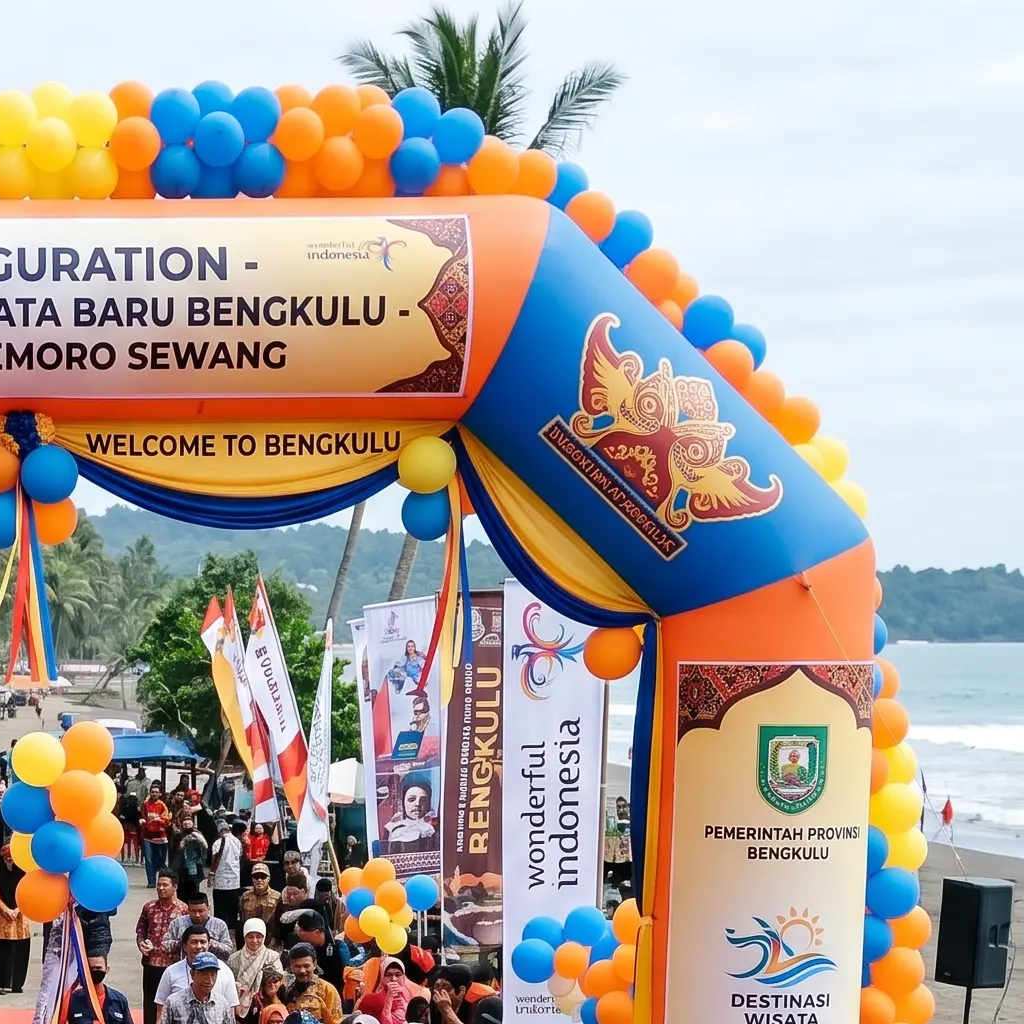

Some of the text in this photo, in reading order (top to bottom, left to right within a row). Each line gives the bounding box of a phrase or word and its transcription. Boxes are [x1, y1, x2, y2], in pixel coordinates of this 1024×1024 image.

[307, 249, 370, 260] indonesia
[73, 297, 174, 328] BARU
[187, 295, 387, 327] BENGKULU
[128, 341, 287, 370] SEWANG
[86, 431, 401, 458] WELCOME TO BENGKULU
[520, 740, 547, 891] wonderful
[548, 716, 582, 891] indonesia
[704, 825, 860, 841] PEMERINTAH PROVINSI
[747, 846, 829, 860] BENGKULU
[731, 993, 830, 1008] DESTINASI
